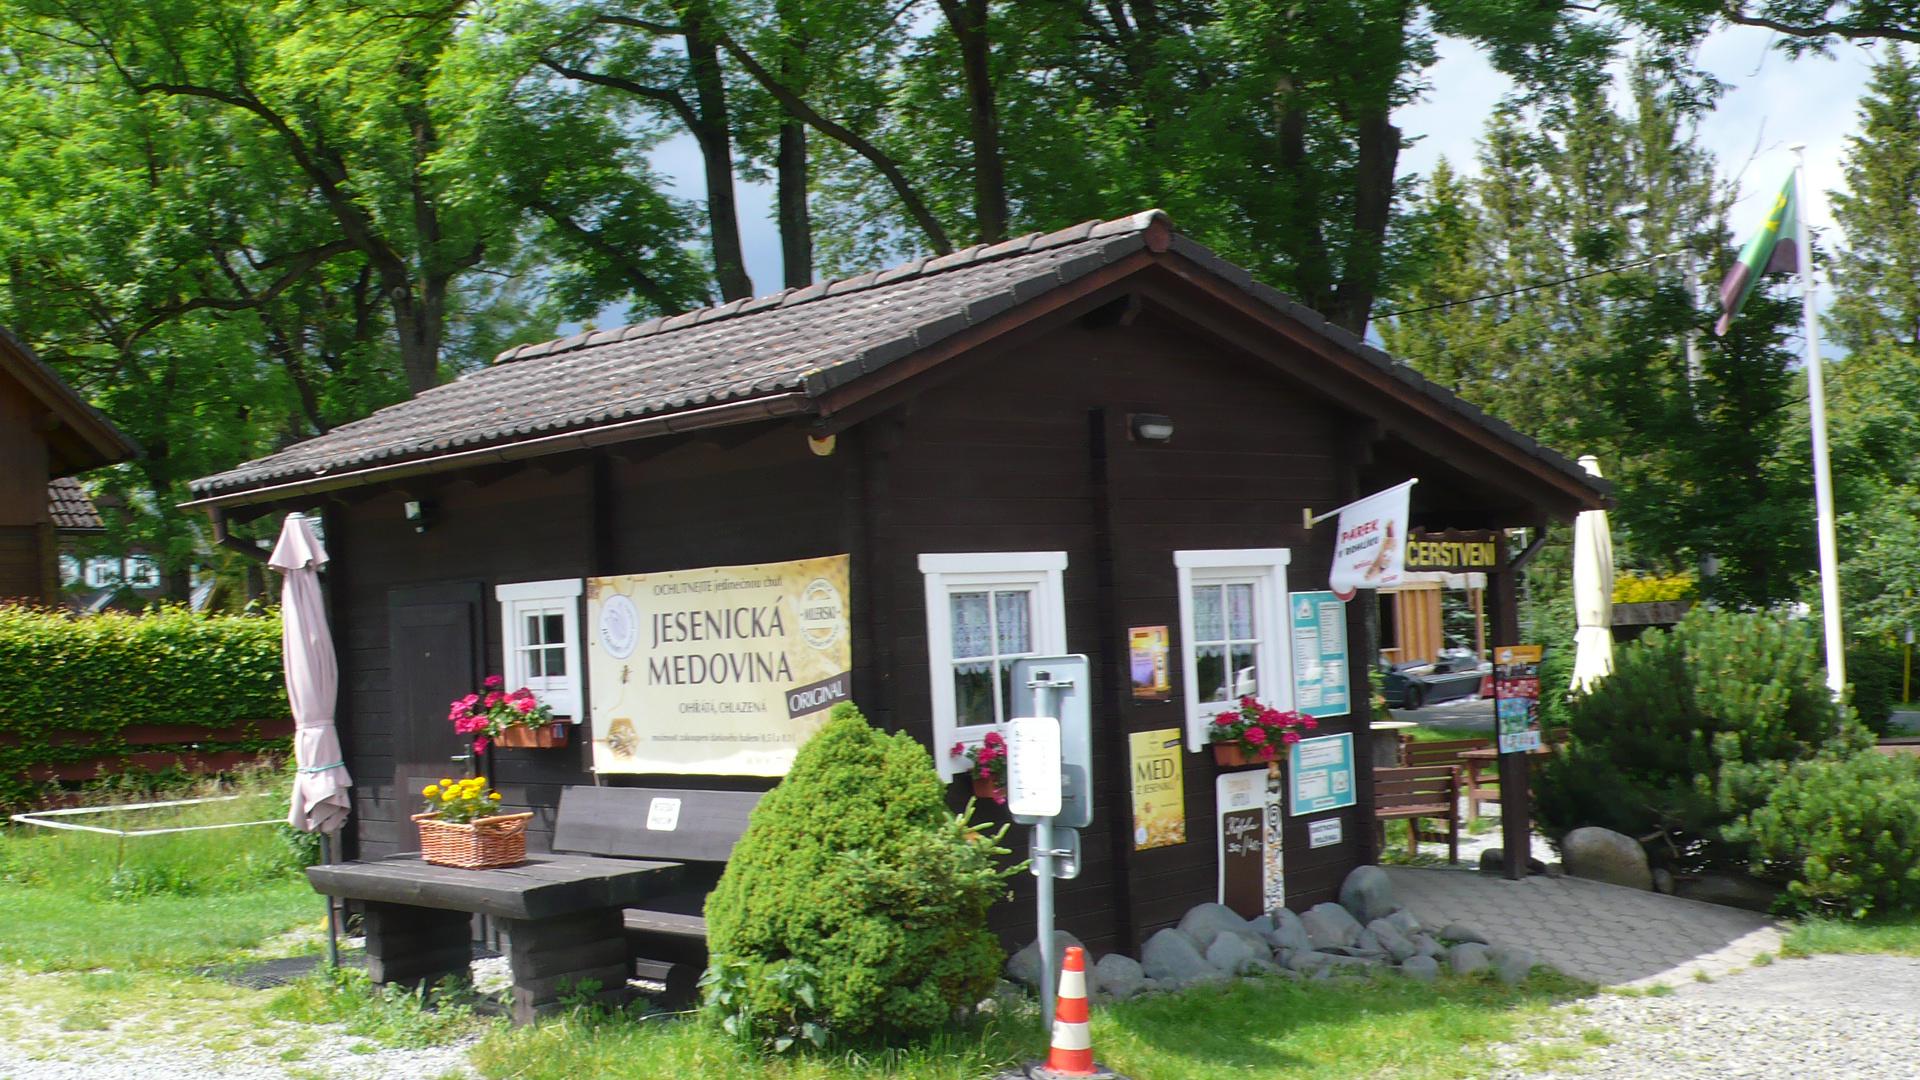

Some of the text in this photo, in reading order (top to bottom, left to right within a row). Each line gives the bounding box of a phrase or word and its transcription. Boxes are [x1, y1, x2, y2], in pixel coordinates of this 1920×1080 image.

[651, 595, 785, 649] JESENICKÁ
[648, 651, 795, 686] MEDOVINA
[789, 680, 846, 712] ORIGINAL
[1135, 758, 1175, 783] MED
